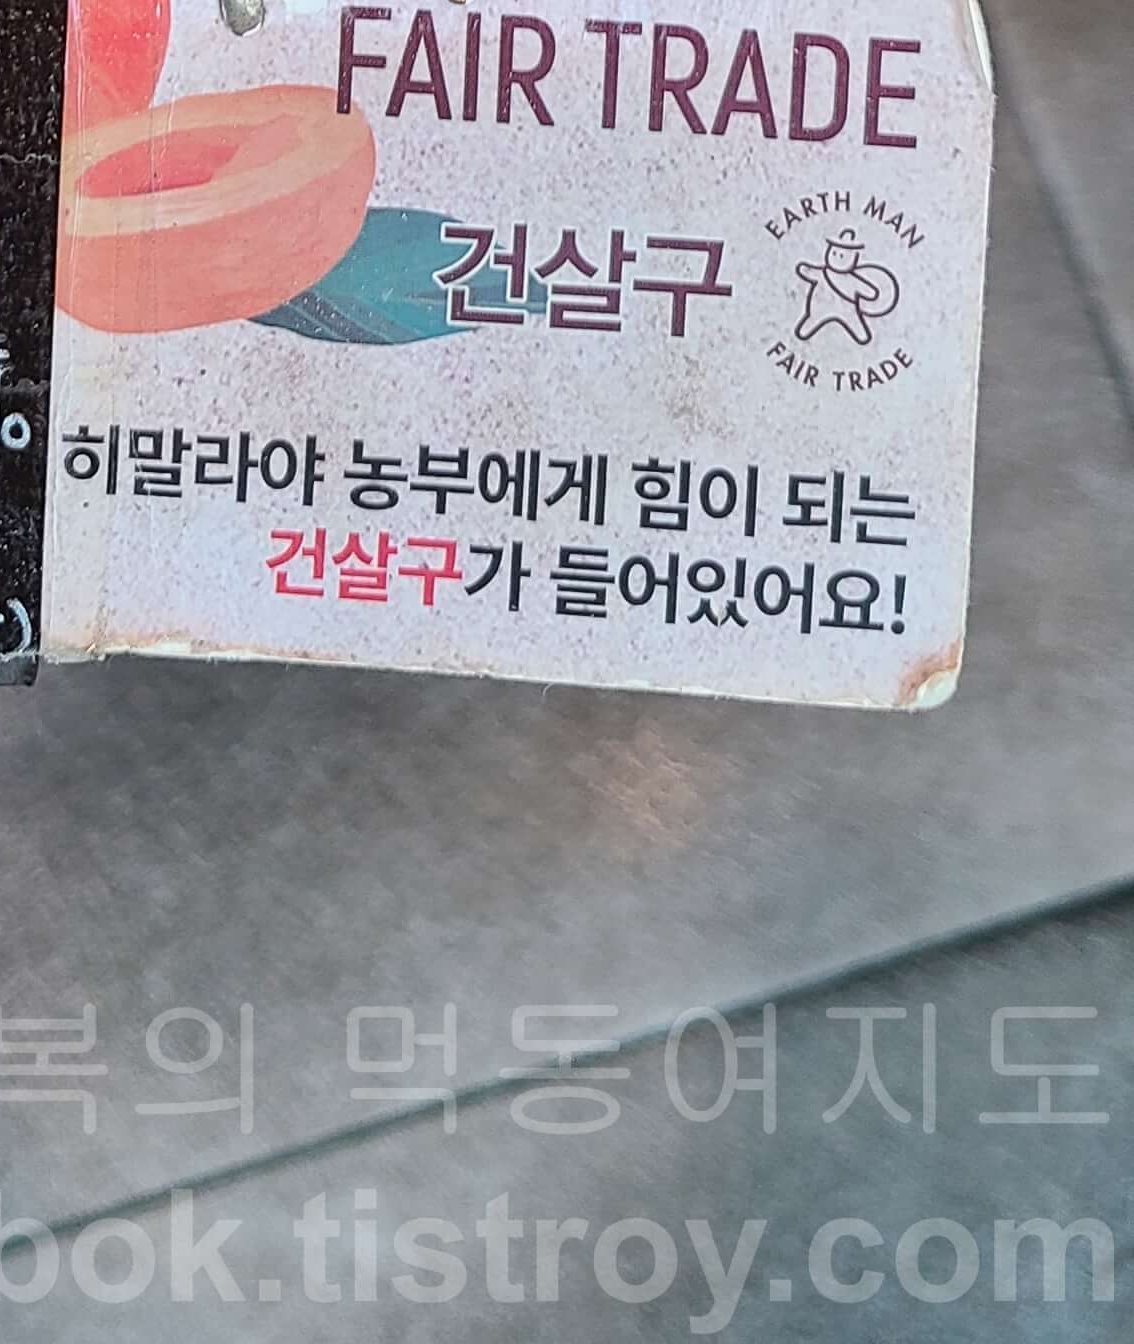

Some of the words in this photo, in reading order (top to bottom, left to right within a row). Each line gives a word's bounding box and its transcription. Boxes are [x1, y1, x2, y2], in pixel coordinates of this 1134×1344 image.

[335, 5, 558, 127] FAIR
[584, 18, 923, 150] TRADE
[764, 190, 851, 241] EARTH
[863, 195, 926, 249] MAN
[431, 220, 734, 338] 건살구
[766, 340, 820, 388] FAIR
[832, 347, 914, 392] TRADE
[60, 422, 328, 509] 히말라야
[342, 438, 609, 528] 농부에게
[631, 457, 761, 537] 힘이
[781, 470, 918, 547] 되는
[264, 525, 531, 613] 건살구가
[551, 545, 909, 637] 들어있어요!
